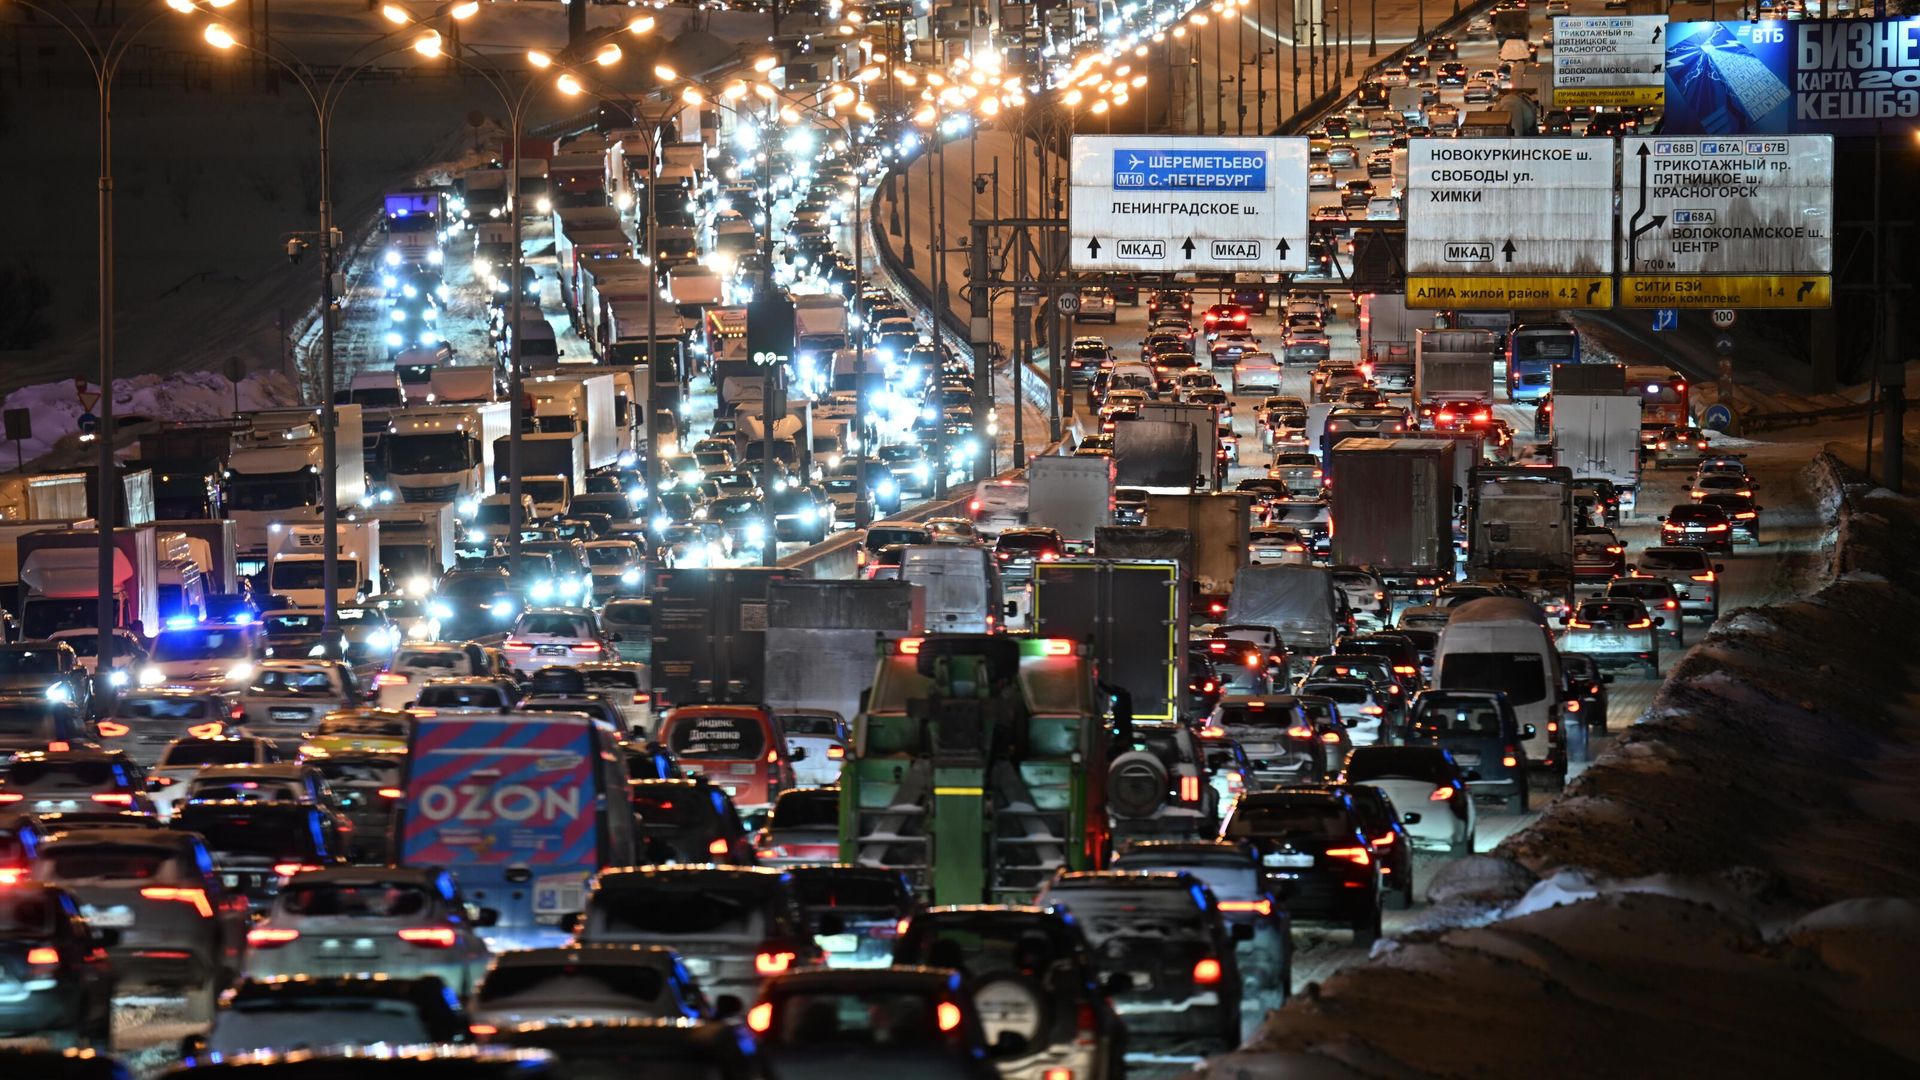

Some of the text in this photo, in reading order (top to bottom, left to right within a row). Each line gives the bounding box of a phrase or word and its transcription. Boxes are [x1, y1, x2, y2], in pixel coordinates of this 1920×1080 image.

[1560, 28, 1622, 37] ТРИКОТАЖНЫЙ
[1752, 27, 1784, 44] ВТБ
[1559, 38, 1608, 46] ПЯТНИЦКОЕ
[1559, 67, 1630, 75] ВОЛОКОЛАМСКОЕ
[1559, 76, 1586, 84] ЦЕНТР
[1797, 71, 1853, 91] КАРТА
[1797, 90, 1919, 121] КЕШБЭ
[1430, 148, 1593, 161] НОВОКУРКИНСКОЕ ш.
[1148, 156, 1264, 169] ШЕРЕМЕТЬЕВО
[1654, 157, 1792, 172] ТРИКОТАЖНЫЙ пр.
[1148, 173, 1253, 187] С.-ПЕТЕРБУРГ
[1431, 169, 1534, 184] СВОБОДЫ ул.
[1653, 173, 1762, 187] ПЯТНИЦКОЕ ш.
[1430, 190, 1482, 203] ХИМКИ
[1653, 186, 1758, 198] КРАСНОГОРСК
[1111, 202, 1260, 217] ЛЕНИНГРАДСКОЕ ш.
[1672, 226, 1824, 239] ВОЛОКОЛАМСКОЕ ш.
[1120, 243, 1163, 258] МКАД
[1214, 243, 1258, 259] МКАД
[1448, 246, 1491, 261] МКАД
[1672, 241, 1719, 255] ЦЕНТР
[1643, 259, 1676, 269] 700 м
[1634, 279, 1703, 292] СИТИ БЭЙ
[1416, 287, 1578, 304] АЛИА жилой район 4.2
[1634, 293, 1741, 304] жилой комплекс
[1766, 287, 1785, 298] 1.4
[1060, 298, 1078, 309] 100
[1714, 311, 1733, 322] 100
[689, 729, 741, 742] Доставка
[418, 784, 580, 821] OZON
